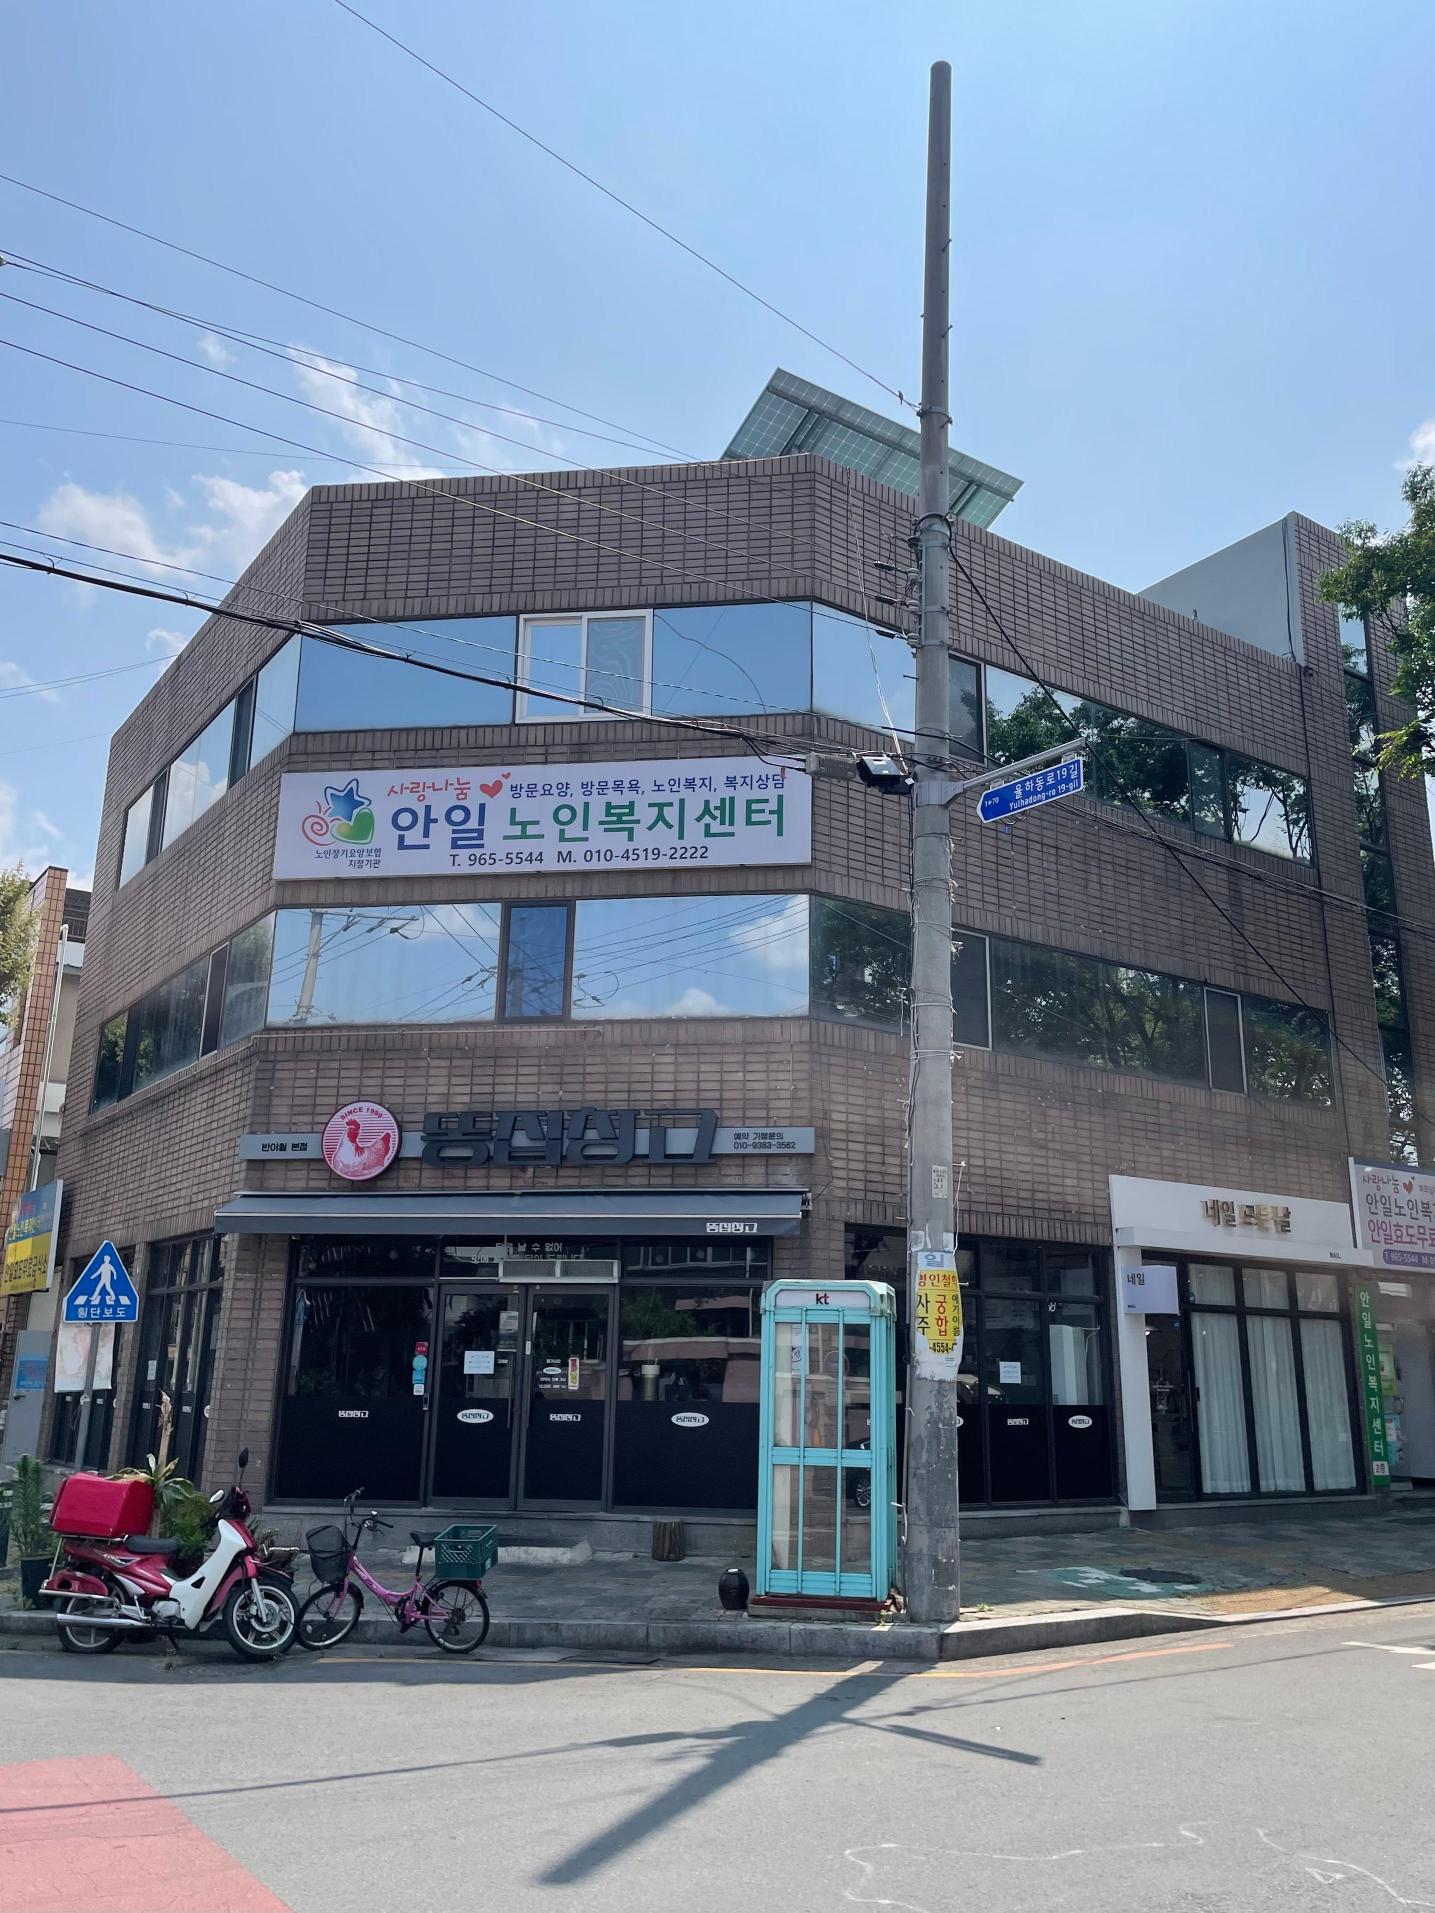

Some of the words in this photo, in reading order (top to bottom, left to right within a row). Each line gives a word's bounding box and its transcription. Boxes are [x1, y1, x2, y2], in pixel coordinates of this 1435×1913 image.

[387, 777, 471, 802] 사랑나눔
[510, 781, 574, 799] 방문요양,
[580, 778, 645, 797] 방문목욕,
[651, 776, 717, 794] 노인복지,
[723, 773, 786, 791] 복지상담
[1009, 788, 1056, 811] Yulhadong-ro
[1057, 779, 1079, 795] 19-gil
[391, 802, 486, 851] 안일
[502, 794, 784, 843] 노인복지센터
[348, 859, 381, 869] 지정기관
[449, 854, 461, 867] T.
[468, 851, 544, 867] 965-5544
[557, 850, 577, 865] M.
[583, 846, 709, 863] 010-4519-2222
[340, 1106, 363, 1120] SINCE
[733, 1132, 750, 1141] 예약
[291, 1142, 308, 1152] 본점
[1362, 1174, 1400, 1194] 사랑나눔
[1201, 1199, 1237, 1228] 네일
[531, 1242, 541, 1252] 수
[544, 1242, 562, 1252] 없어
[1127, 1272, 1145, 1286] 네일
[815, 1292, 829, 1305] kt
[77, 1306, 127, 1319] 횡단보도
[935, 1294, 949, 1337] 궁합
